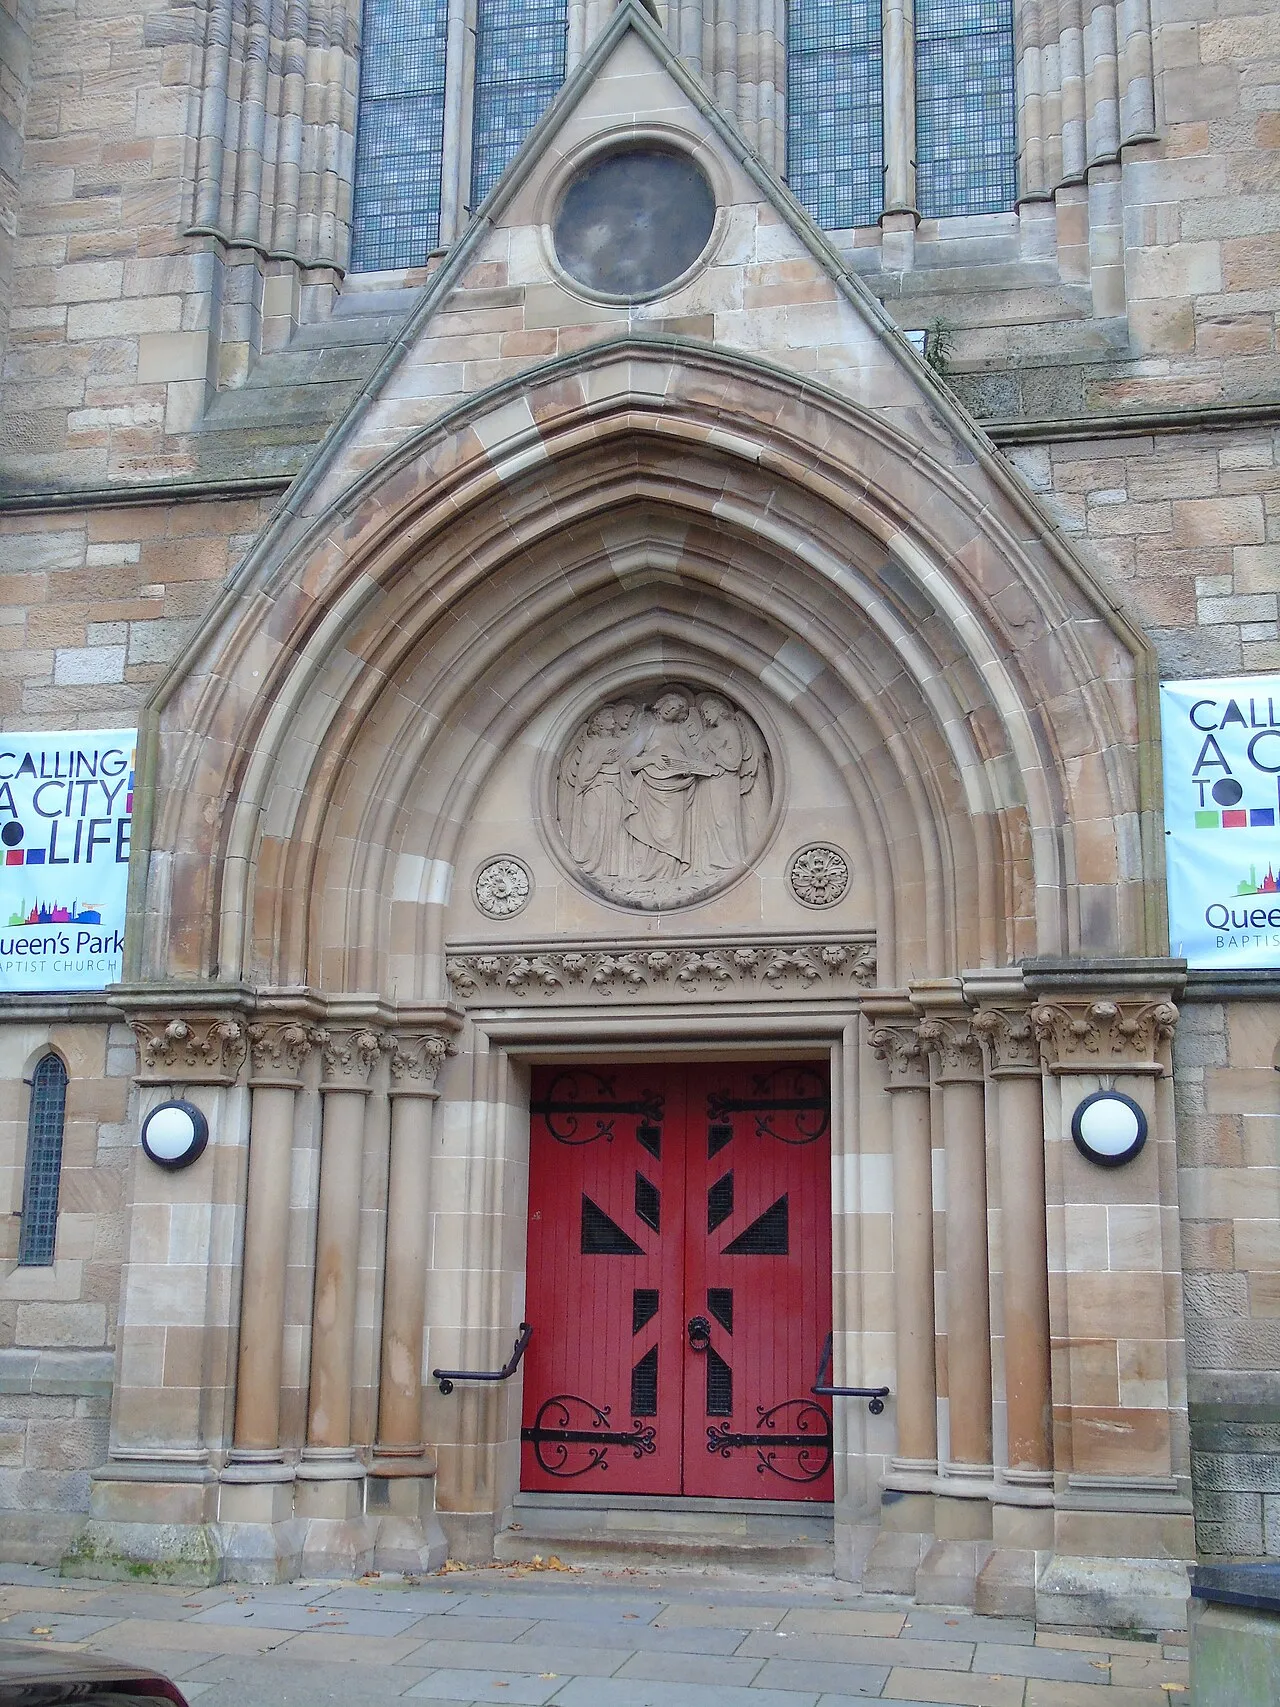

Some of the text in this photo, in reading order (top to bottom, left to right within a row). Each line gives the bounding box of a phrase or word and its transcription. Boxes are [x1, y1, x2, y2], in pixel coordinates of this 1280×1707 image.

[1189, 698, 1280, 731] CALL
[0, 749, 128, 779] CALLING
[1192, 733, 1232, 776] A
[33, 778, 126, 818] CITY
[1192, 778, 1243, 807] TO
[0, 818, 131, 864] O LIFE
[1205, 904, 1280, 931] Quee
[76, 930, 124, 954] Park
[1216, 935, 1280, 949] BAPTIS
[53, 960, 117, 971] CHURCH
